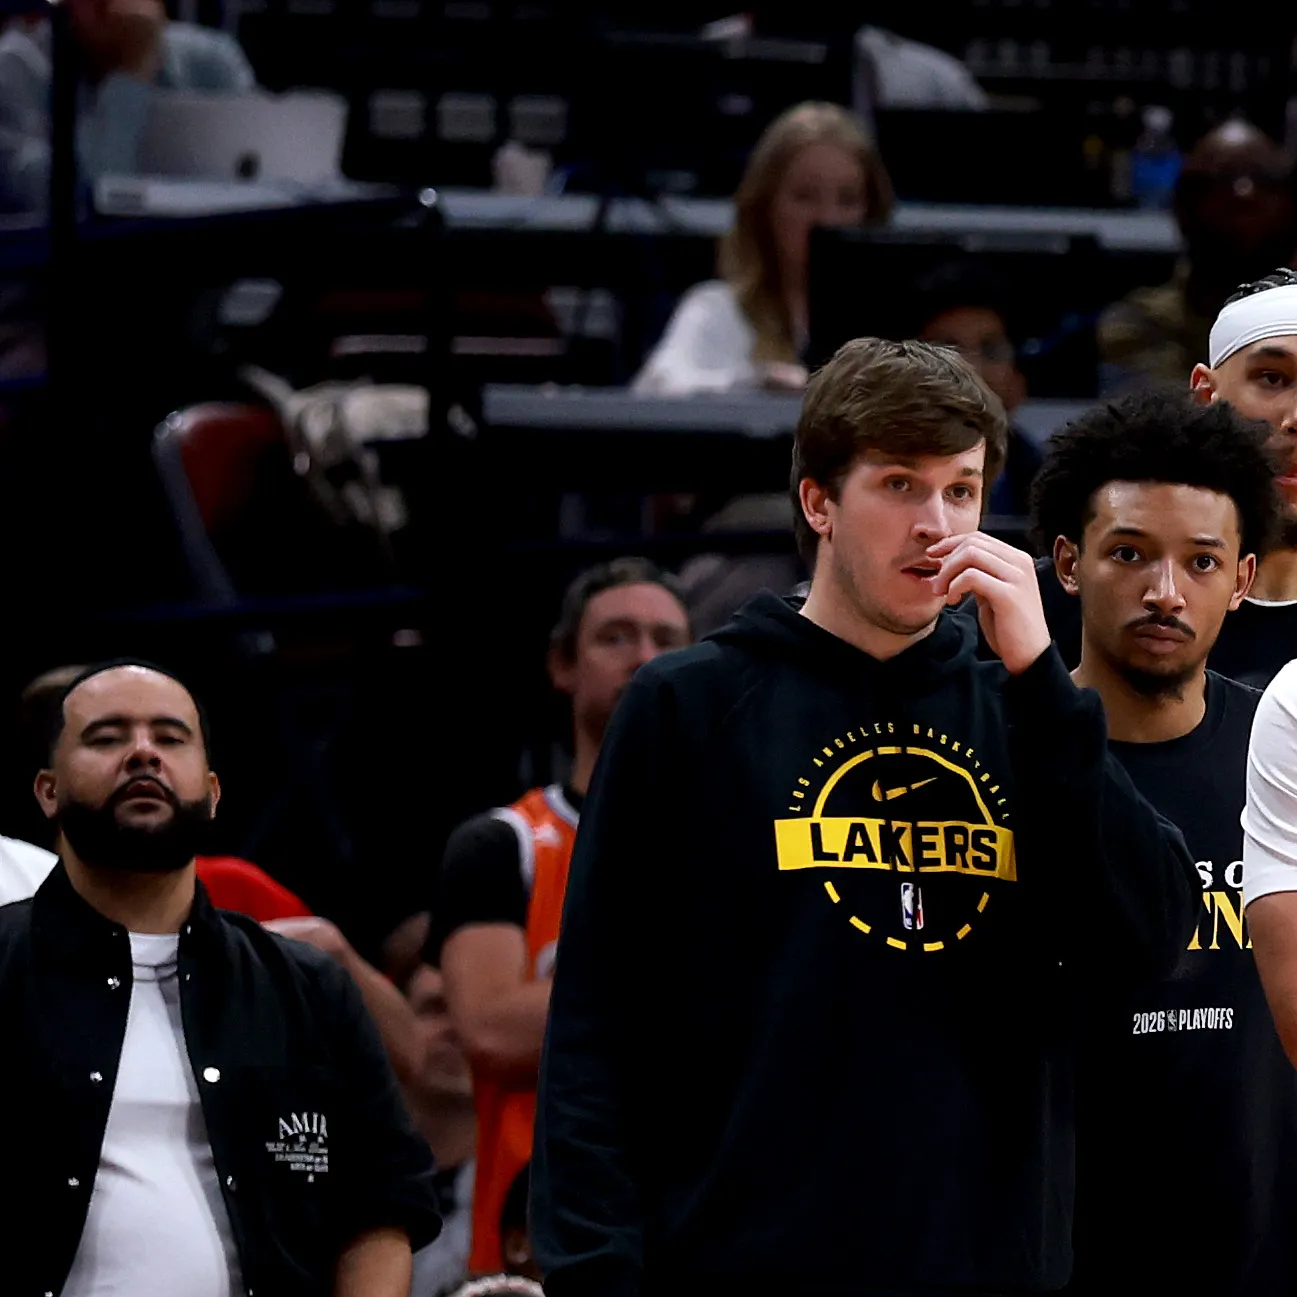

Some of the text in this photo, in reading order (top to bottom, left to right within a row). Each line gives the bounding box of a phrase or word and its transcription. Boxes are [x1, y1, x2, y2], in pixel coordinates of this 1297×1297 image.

[788, 722, 1010, 820] LOS ANGELES BASKETBALL
[809, 822, 999, 871] LAKERS
[1132, 1007, 1234, 1035] 2026 PLAYOFFS
